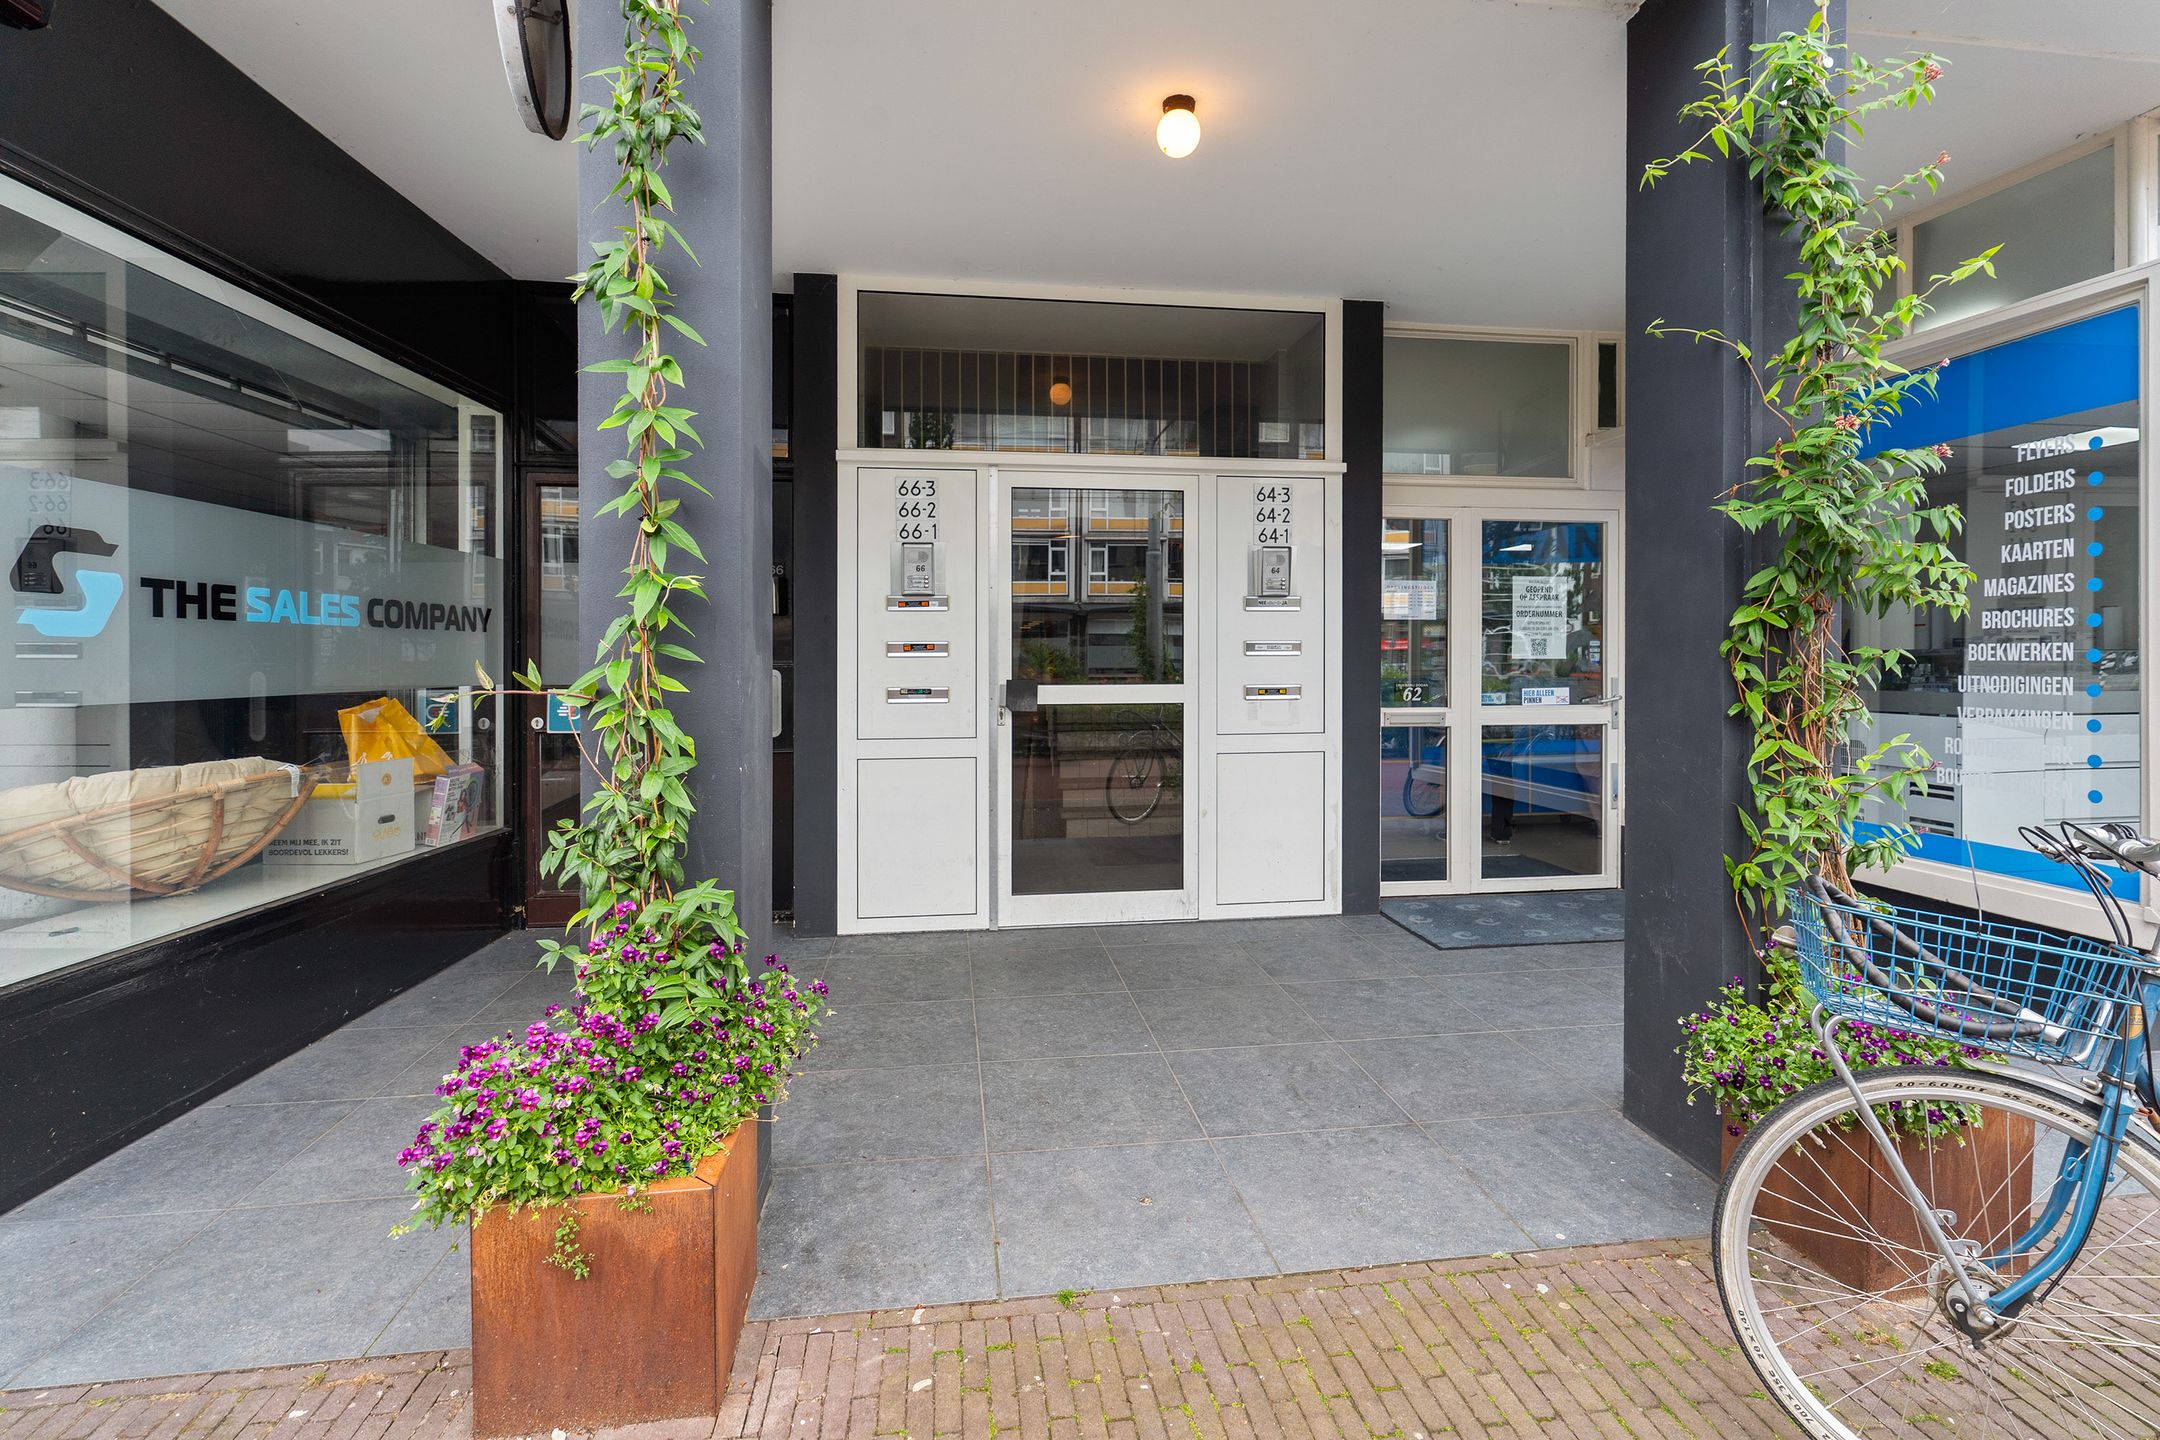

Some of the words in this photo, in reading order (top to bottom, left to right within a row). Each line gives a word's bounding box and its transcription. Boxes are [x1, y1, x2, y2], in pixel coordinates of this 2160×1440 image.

[2017, 434, 2076, 463] FLYERS
[898, 480, 935, 496] 66-3
[2005, 468, 2076, 498] FOLDERS
[1256, 487, 1290, 502] 64-3
[899, 502, 936, 518] 66-2
[1256, 507, 1290, 523] 64-2
[2004, 503, 2076, 531] POSTERS
[899, 523, 937, 539] 66-1
[1258, 527, 1289, 543] 64-1
[2001, 538, 2075, 564] KAARTEN
[915, 564, 926, 572] 66
[1983, 572, 2075, 597] MAGAZINES
[140, 577, 237, 621] THE
[246, 587, 360, 627] SALES
[367, 598, 492, 632] COMPANY
[1516, 610, 1563, 618] ORDERNUMMER
[1981, 607, 2075, 629] BROCHURES
[1967, 642, 2074, 662] BOEKWERKEN
[1403, 687, 1422, 701] 62
[1957, 675, 2074, 696] UITNODIGINGEN
[1957, 706, 2073, 730] VERPAKKINGEN
[268, 848, 313, 856] BOORDEVOL
[315, 848, 348, 856] LEKKERS!
